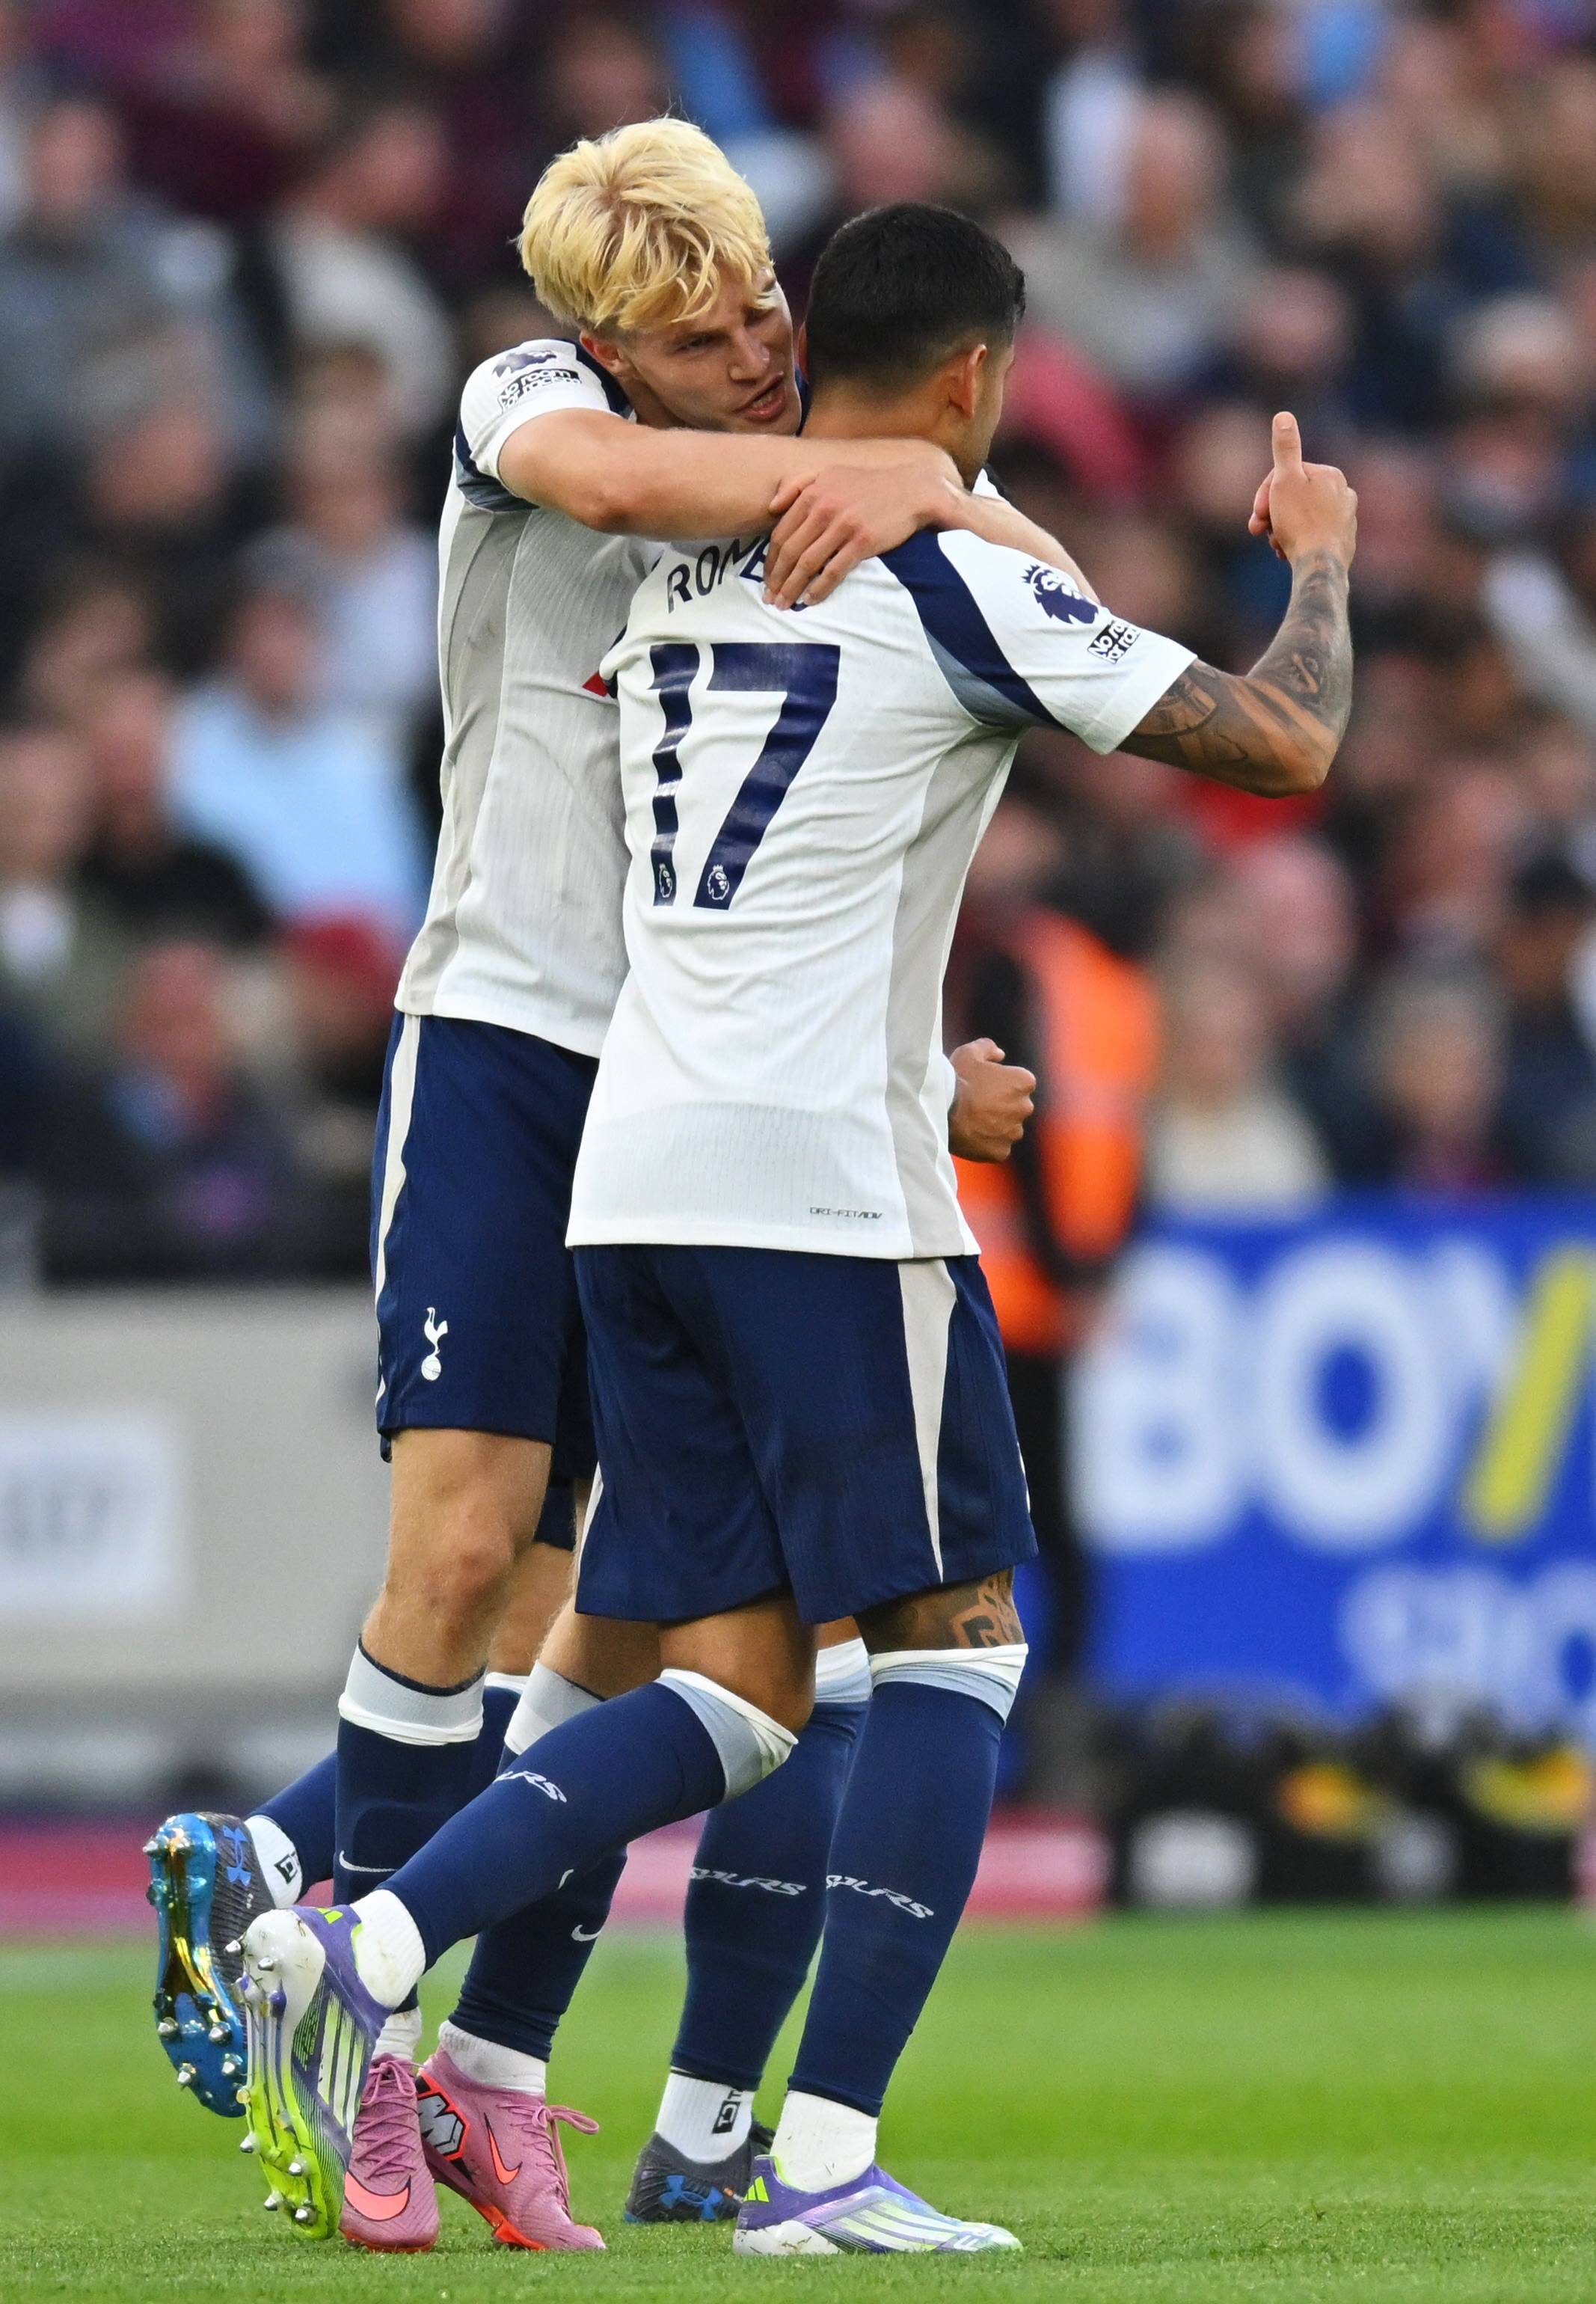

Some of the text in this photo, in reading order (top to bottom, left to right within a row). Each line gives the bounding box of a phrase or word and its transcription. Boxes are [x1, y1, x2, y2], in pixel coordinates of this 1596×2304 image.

[521, 369, 572, 385] room
[667, 536, 808, 612] ROME
[1087, 634, 1114, 660] No
[648, 643, 841, 910] 17
[826, 1875, 934, 1919] SPURS
